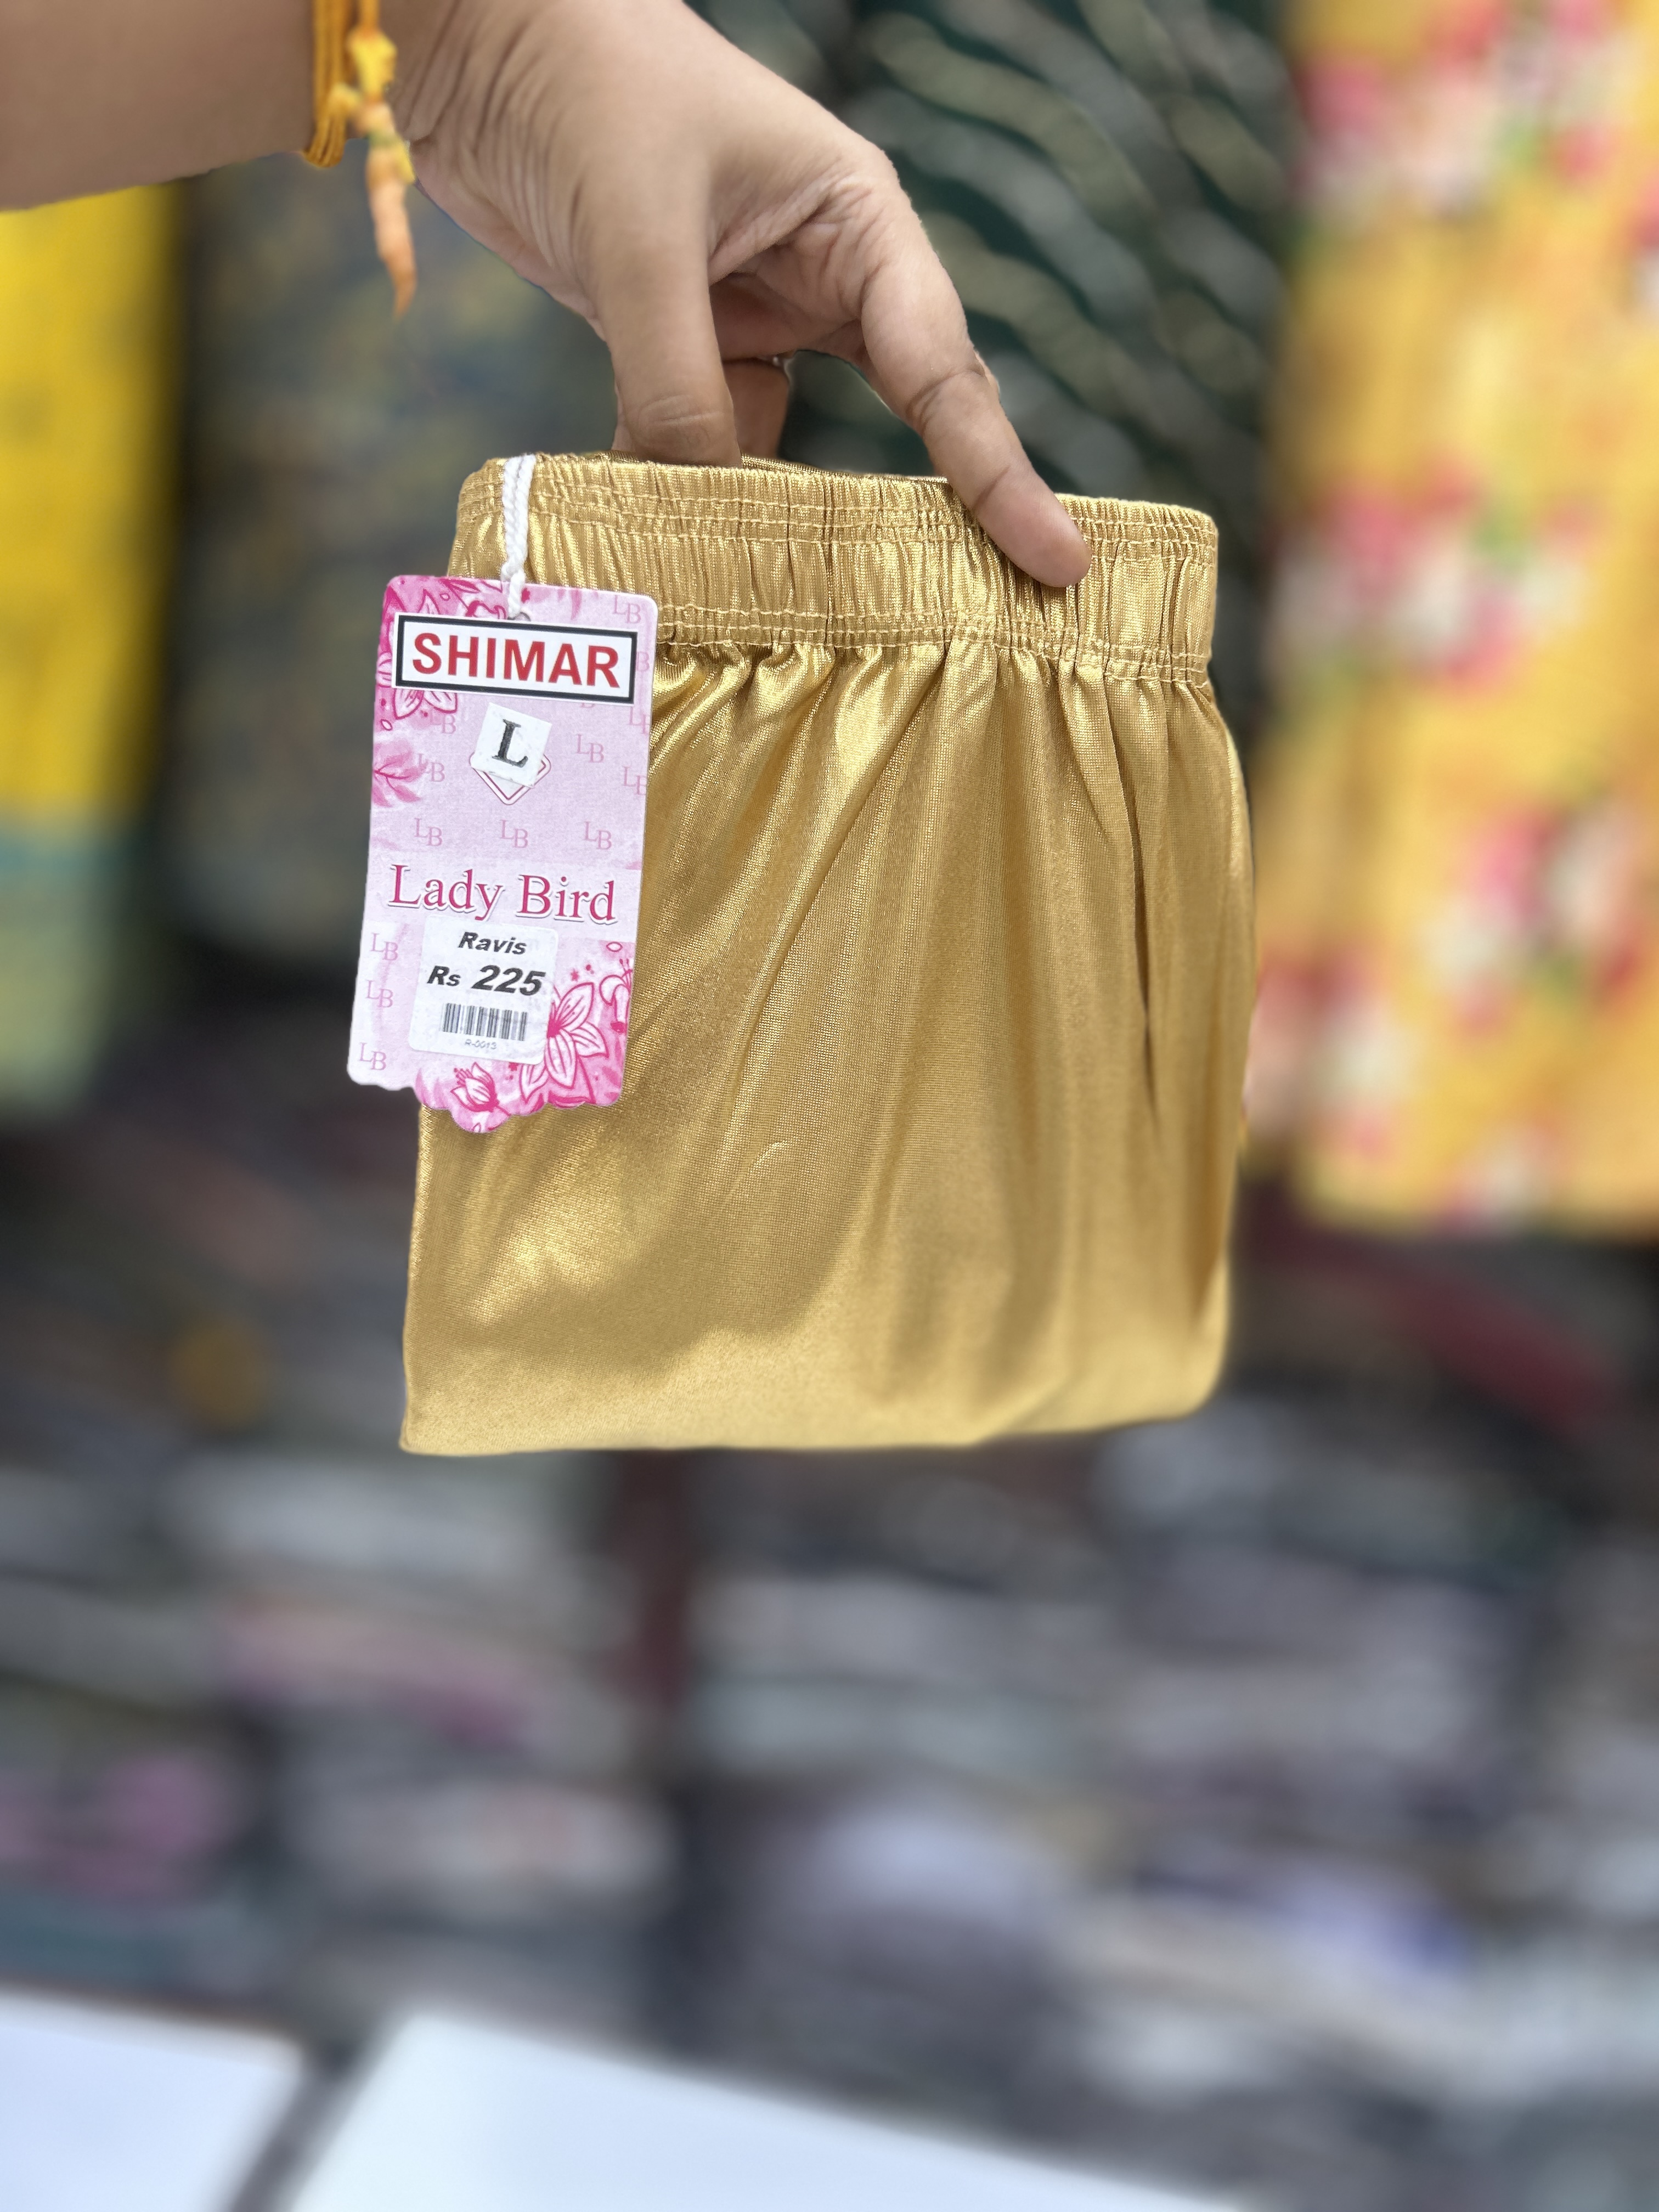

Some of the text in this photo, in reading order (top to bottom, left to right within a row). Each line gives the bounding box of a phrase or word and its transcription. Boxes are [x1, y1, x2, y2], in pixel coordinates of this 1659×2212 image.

[612, 594, 641, 624] LB
[412, 633, 621, 689] SHIMAR
[491, 719, 528, 769] L
[577, 733, 605, 763] LB
[414, 818, 443, 847] LB
[500, 820, 528, 848] LB
[584, 821, 612, 850] LB
[389, 864, 618, 924] Lady Bird
[371, 933, 399, 961] LB
[458, 932, 527, 955] Ravis
[366, 980, 394, 1008] LB
[427, 964, 546, 996] Rs 225
[359, 1043, 387, 1071] LB
